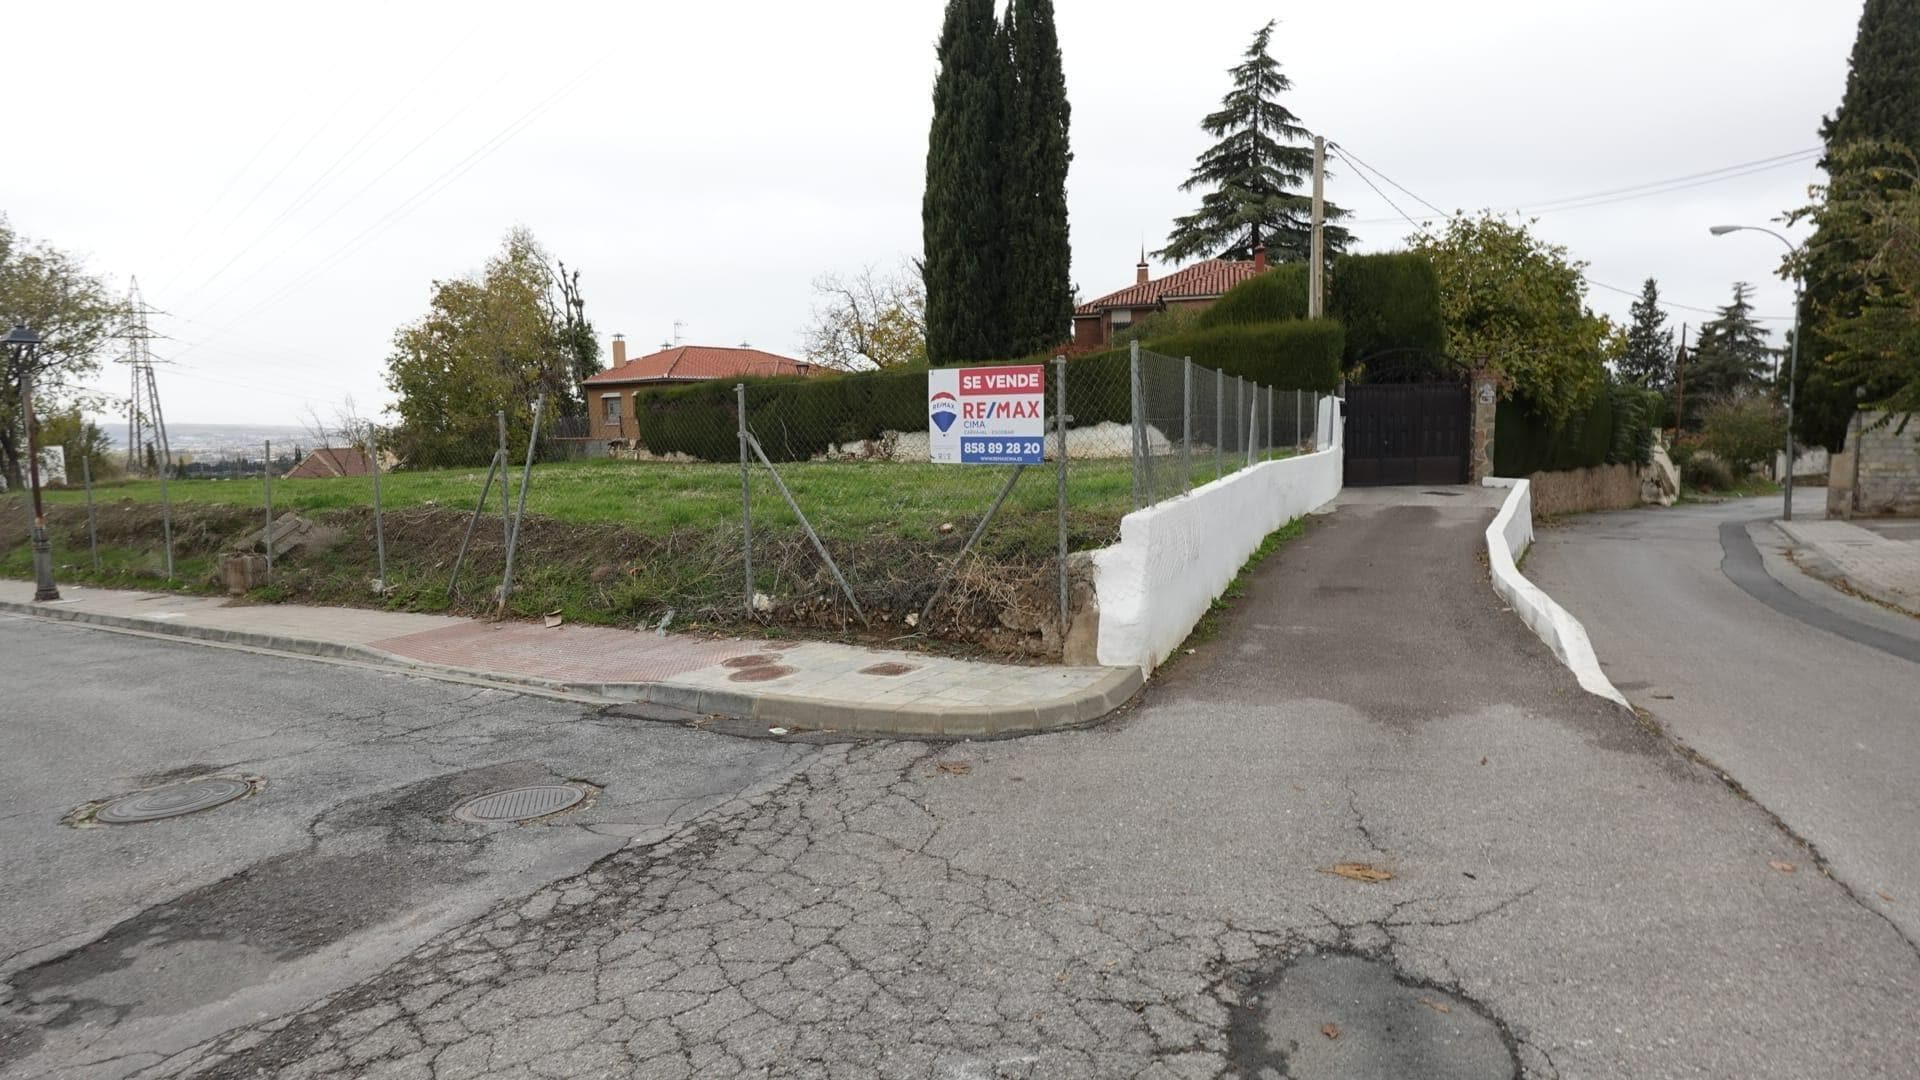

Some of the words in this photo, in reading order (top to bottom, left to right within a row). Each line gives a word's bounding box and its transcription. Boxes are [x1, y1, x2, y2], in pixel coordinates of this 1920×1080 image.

[963, 375, 982, 389] SE
[985, 373, 1039, 389] VENDE
[963, 401, 1040, 419] RE/MAX
[963, 420, 985, 429] CIMA
[964, 442, 985, 454] 858
[987, 442, 1003, 454] 89
[1006, 442, 1021, 454] 28
[1023, 442, 1040, 454] 20
